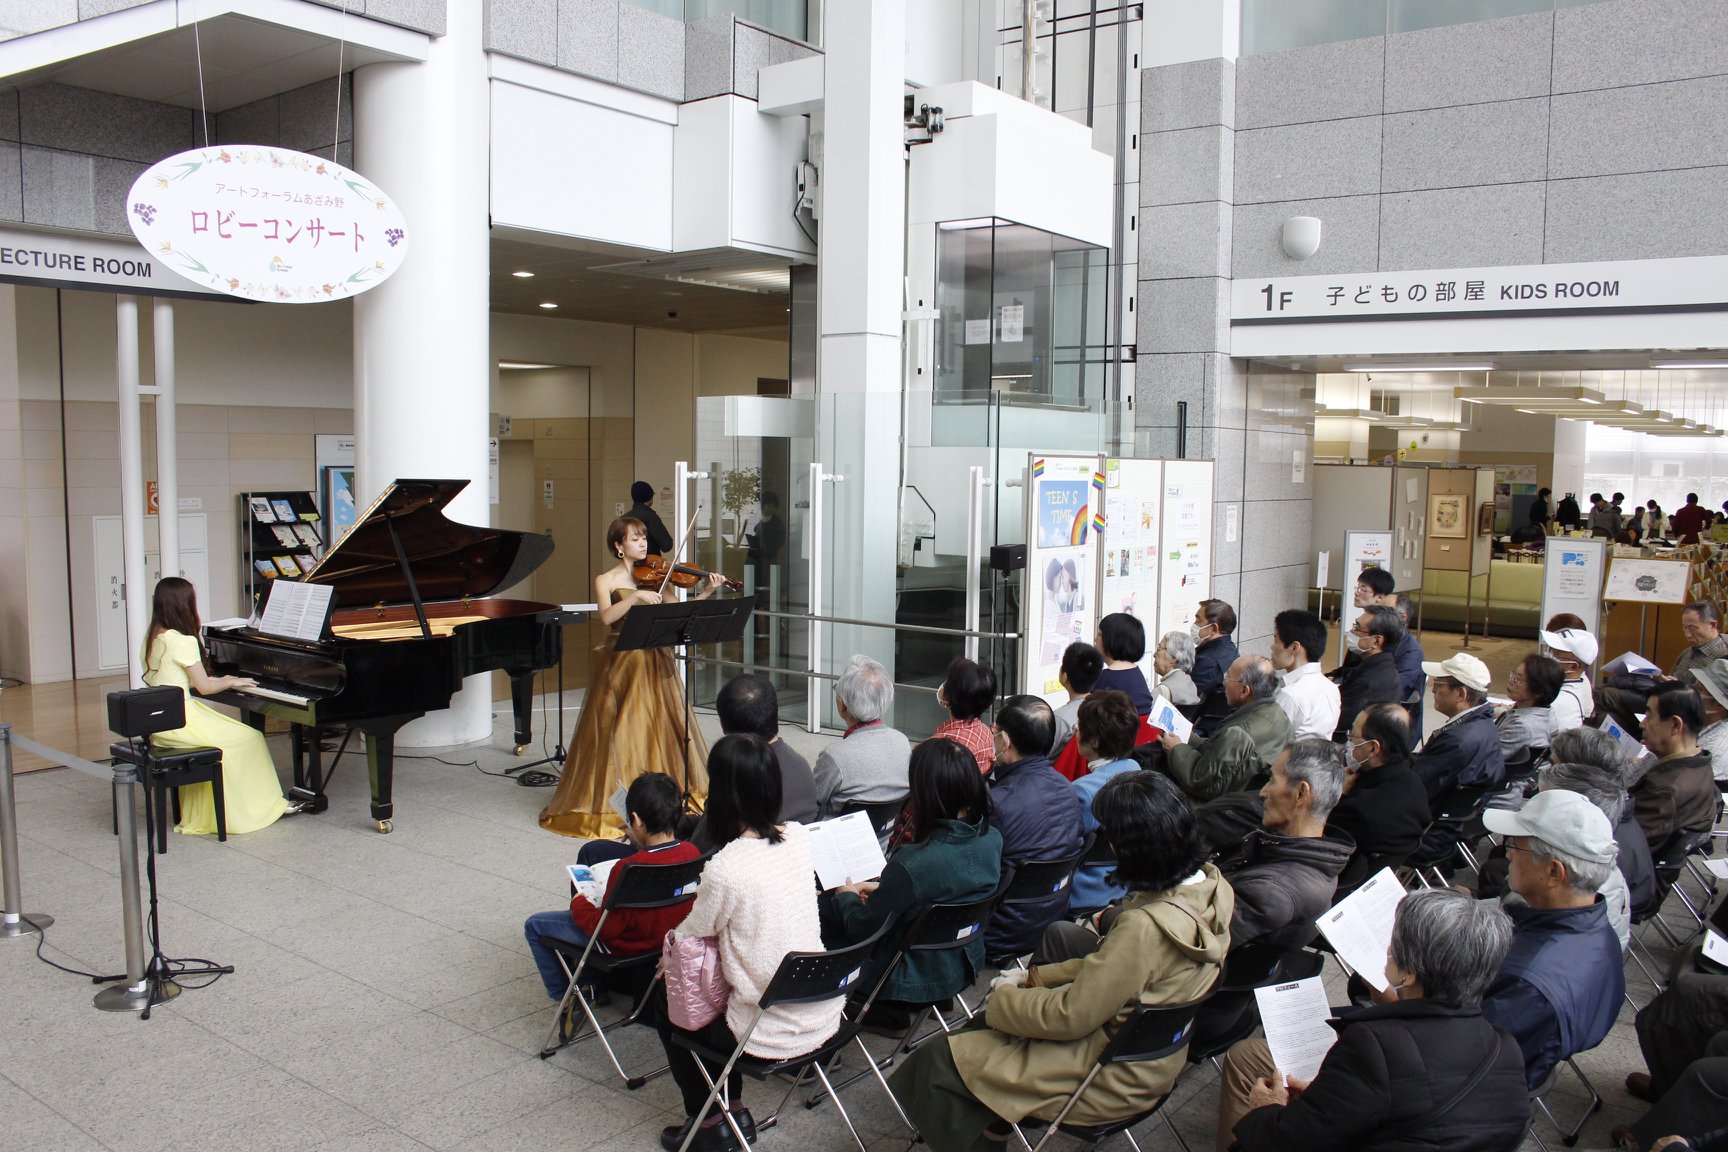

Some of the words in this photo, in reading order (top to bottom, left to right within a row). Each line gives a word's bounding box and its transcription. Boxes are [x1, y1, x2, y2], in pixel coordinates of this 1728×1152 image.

[215, 183, 345, 209] アートフォーラムあざみ野
[190, 210, 365, 253] ロビーコンサート
[0, 247, 86, 271] ECTURE
[93, 257, 152, 278] ROOM
[1261, 284, 1293, 311] 1F
[1326, 280, 1486, 306] 子どもの部屋
[1500, 284, 1548, 300] KIDS
[1555, 281, 1620, 298] ROOM
[1051, 509, 1073, 524] TIME
